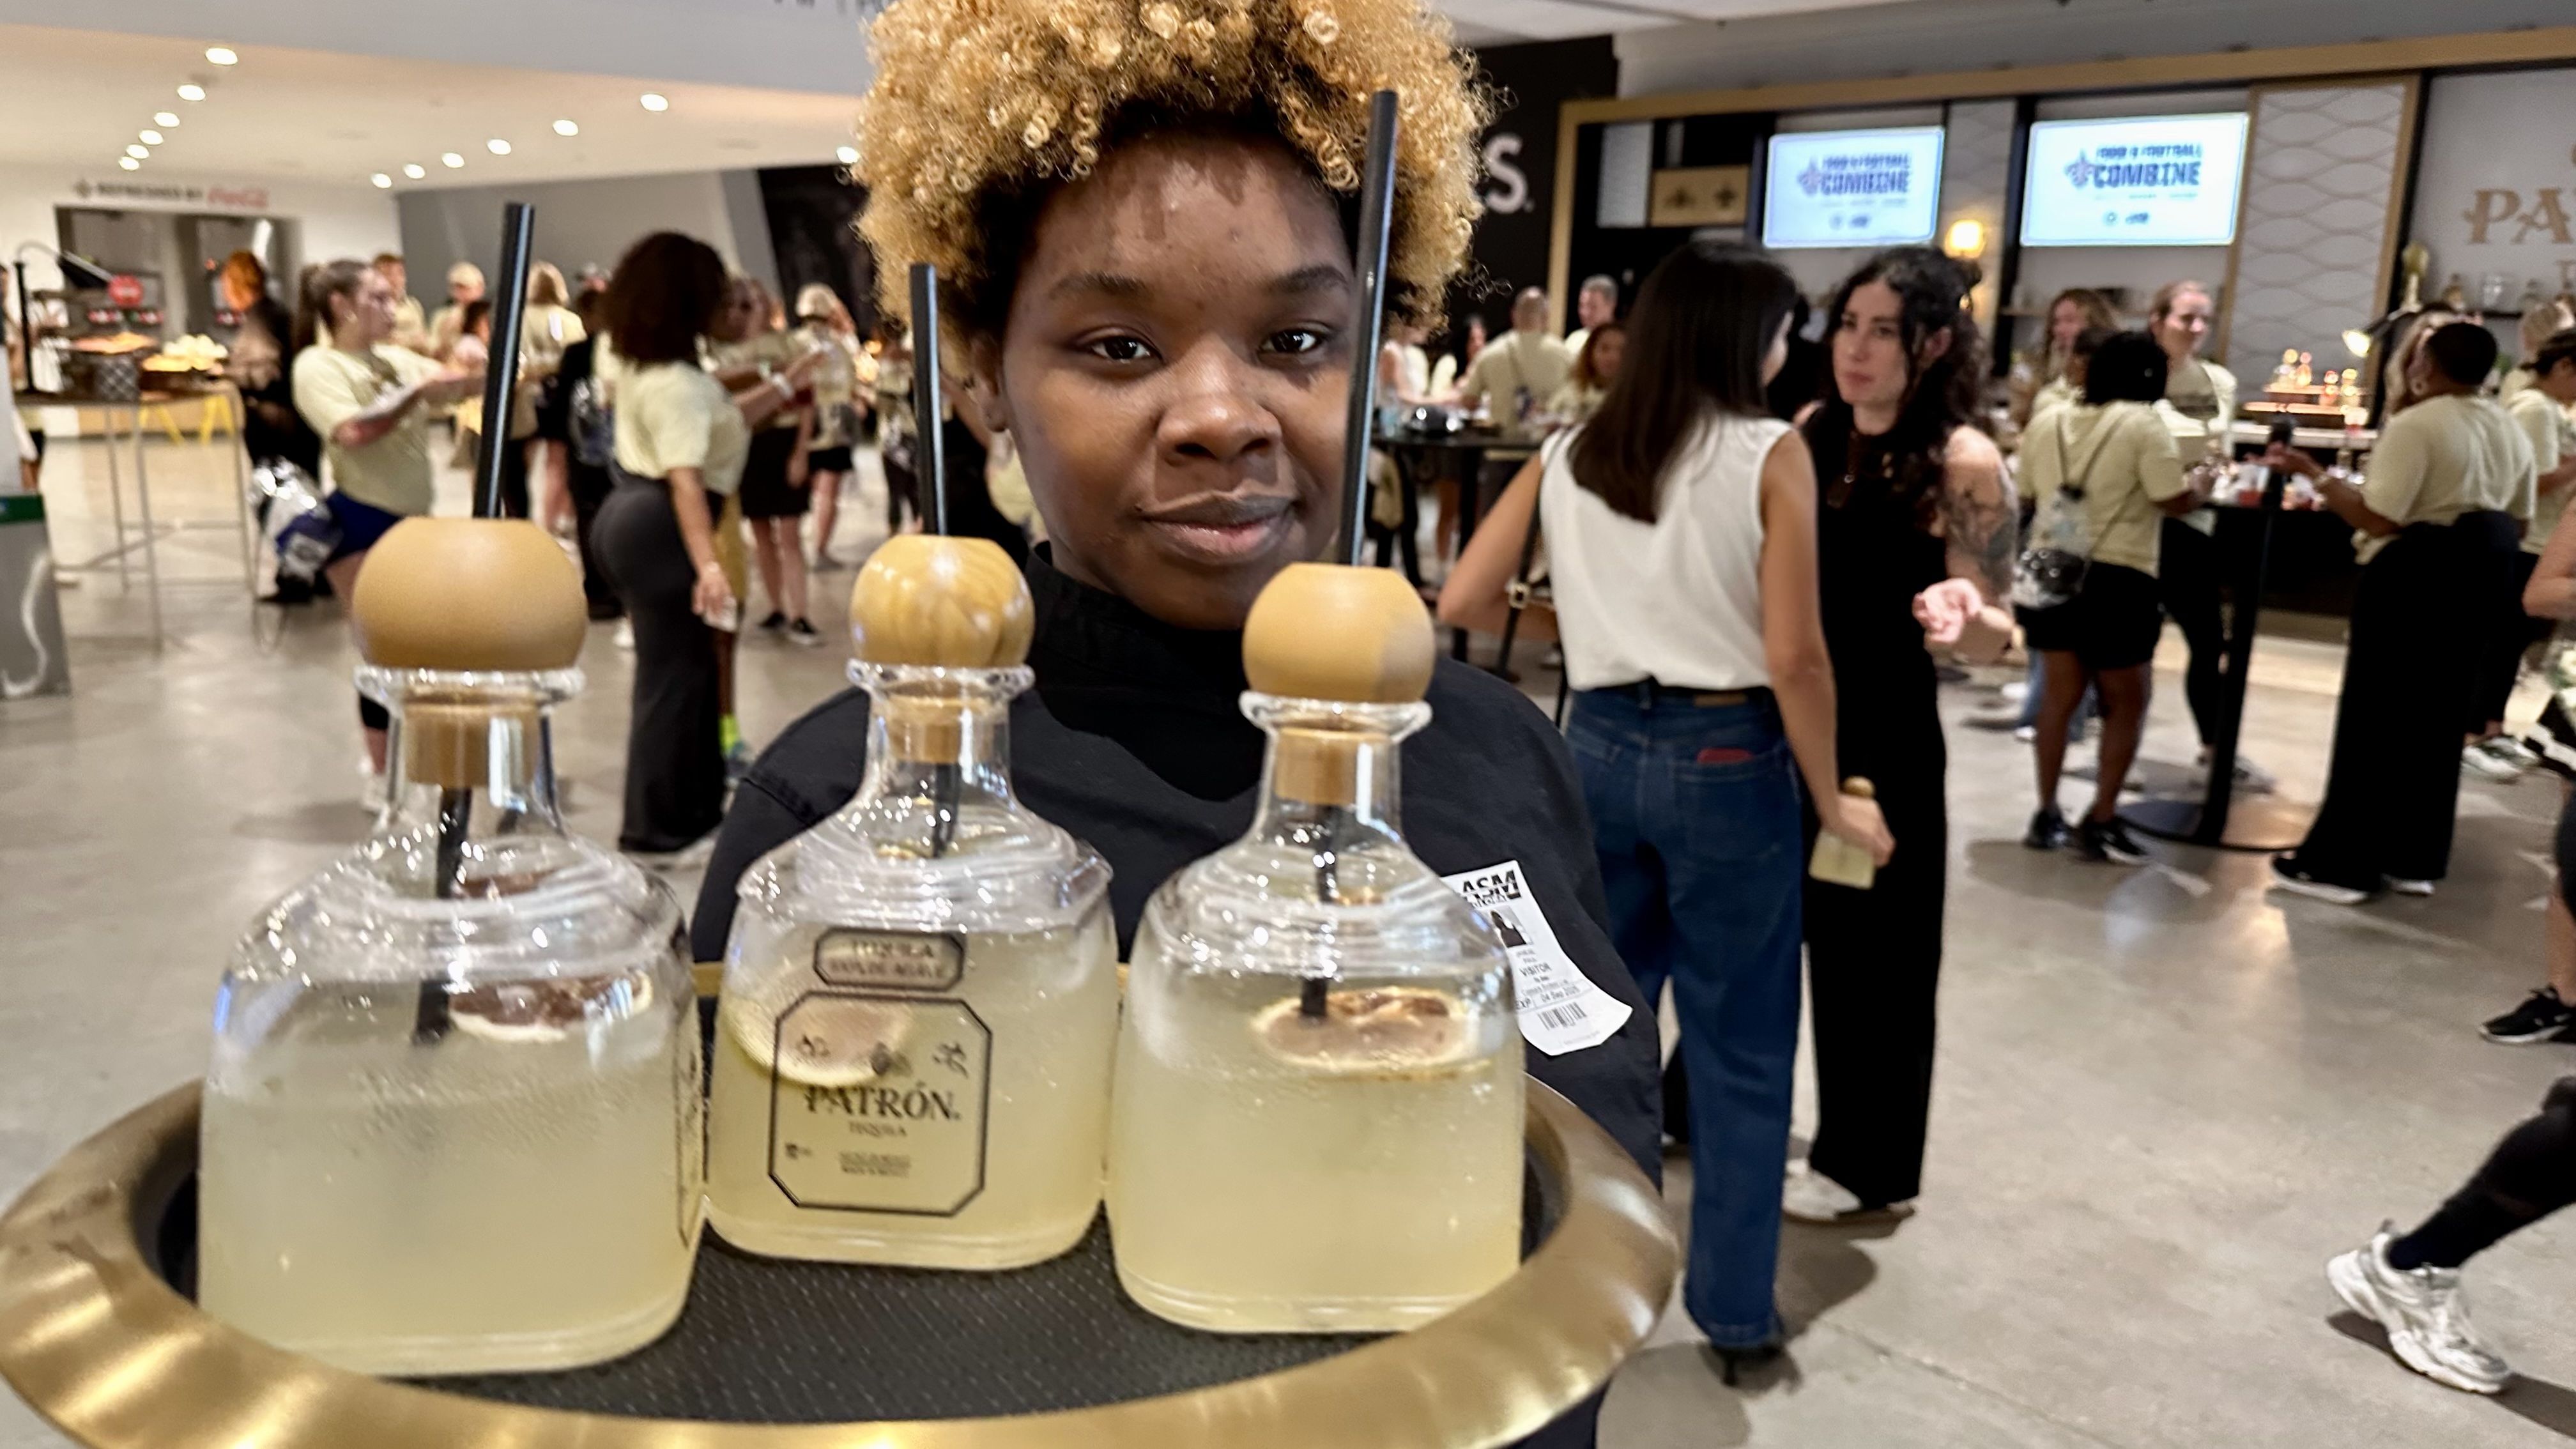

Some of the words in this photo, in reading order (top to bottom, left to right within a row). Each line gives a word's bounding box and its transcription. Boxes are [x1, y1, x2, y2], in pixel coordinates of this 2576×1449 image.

[1821, 171, 1909, 195] COMBINE
[2094, 161, 2201, 188] COMBINE
[1519, 962, 1552, 977] VISITOR
